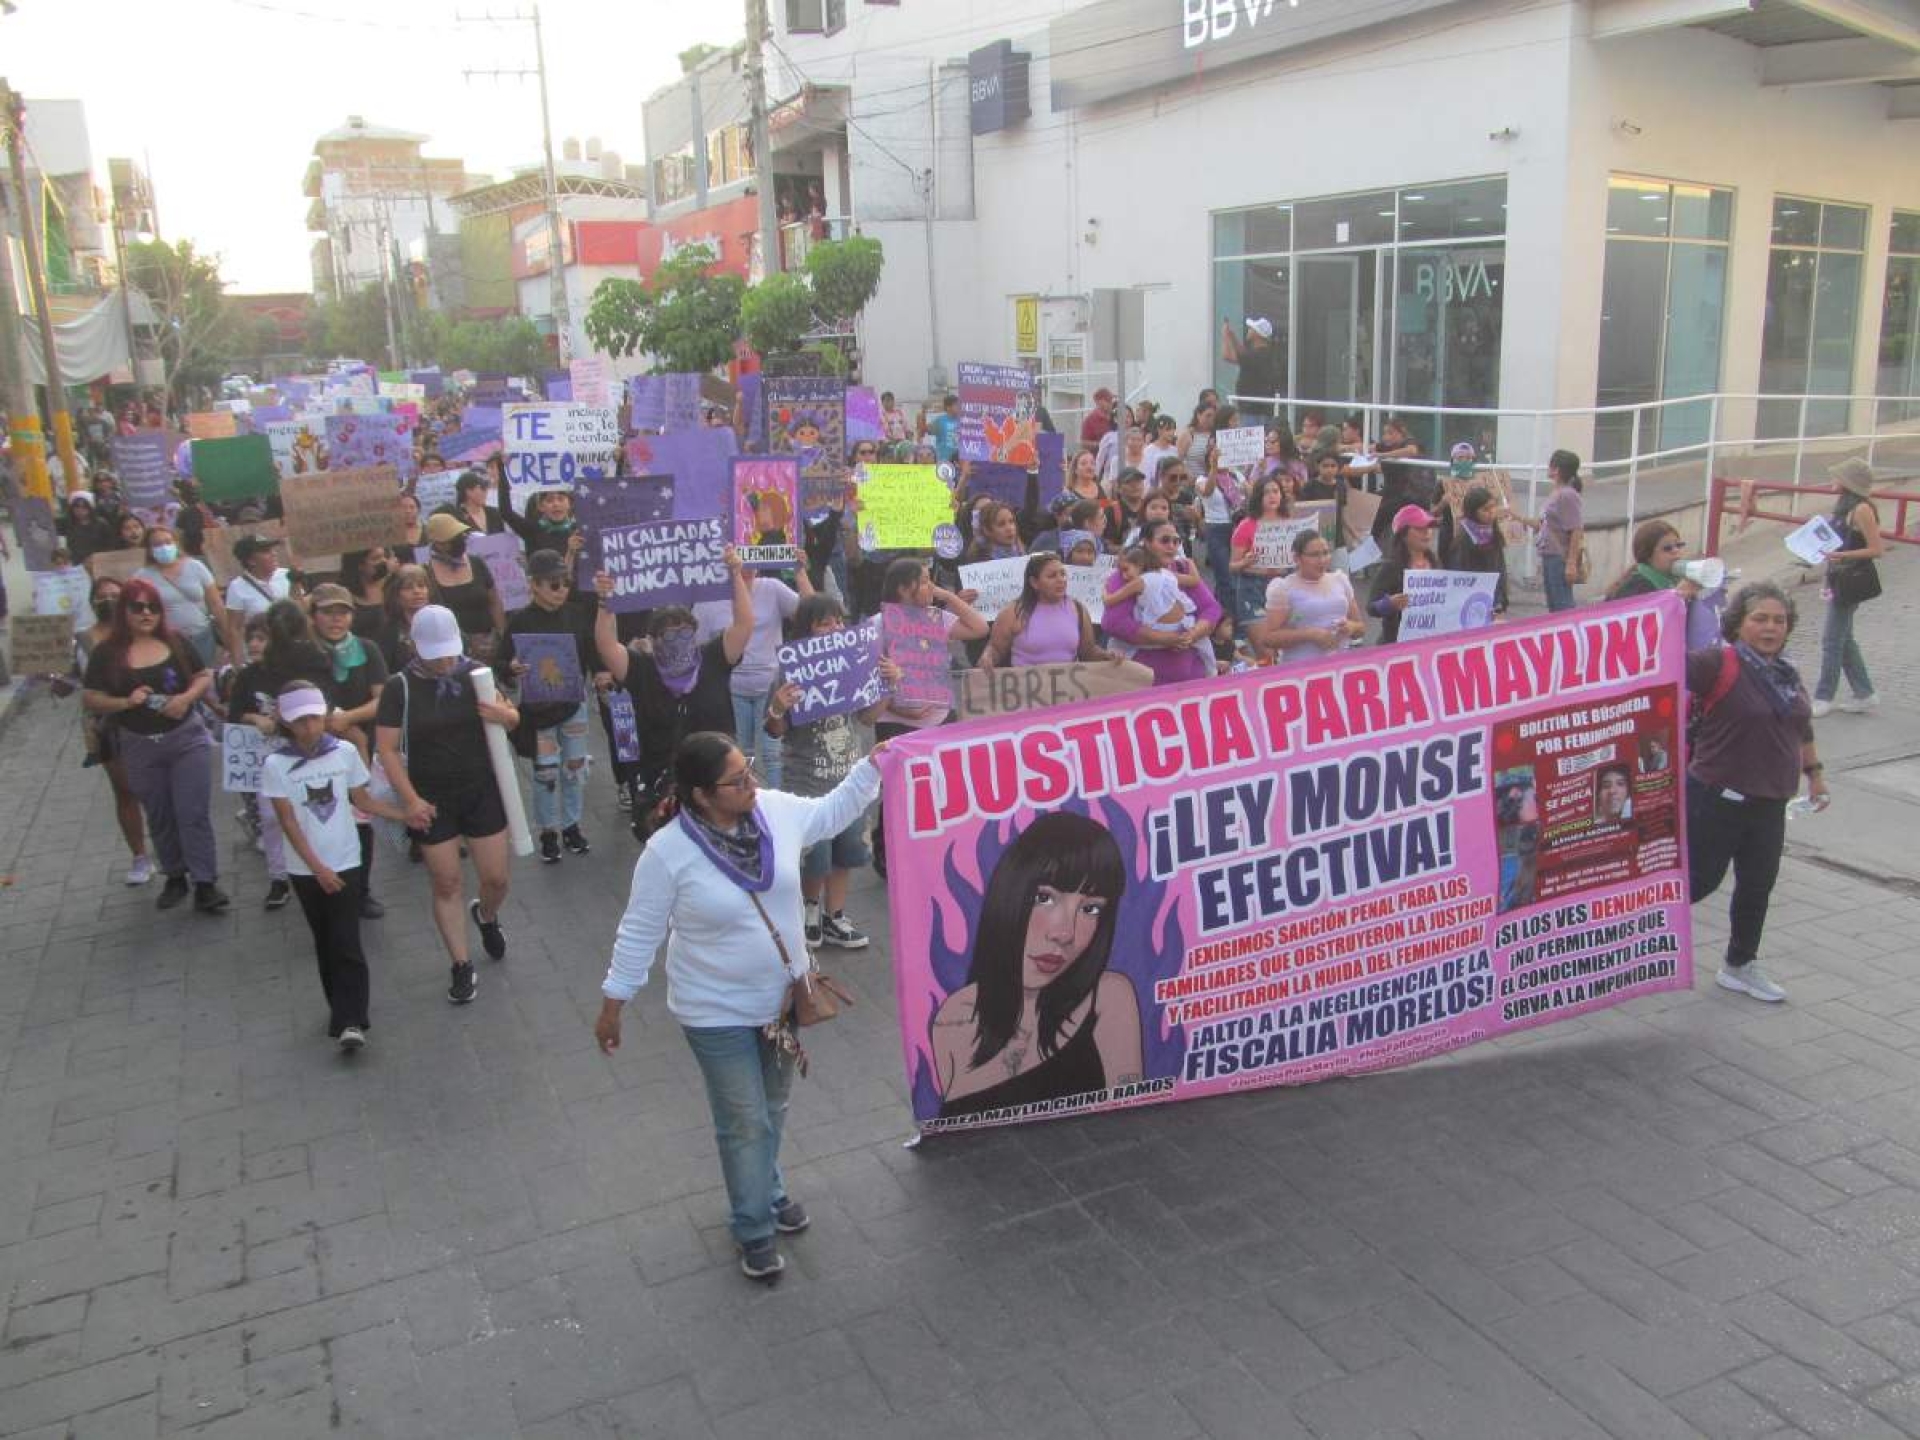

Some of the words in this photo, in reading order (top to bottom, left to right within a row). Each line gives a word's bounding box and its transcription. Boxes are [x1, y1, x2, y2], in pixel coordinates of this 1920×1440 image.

[972, 76, 999, 102] BBVA
[1417, 260, 1492, 302] BBVA
[510, 412, 555, 441] TE
[506, 451, 576, 486] CREO
[602, 534, 625, 553] NI
[627, 519, 722, 546] CALLADAS
[604, 554, 627, 574] NI
[631, 539, 725, 571] SUMISAS
[777, 630, 857, 665] QUIERO
[785, 655, 850, 683] MUCHA
[965, 664, 1091, 715] LIBRES
[1263, 661, 1429, 754] PARA
[1437, 613, 1659, 716] MAYLIN!
[1573, 710, 1590, 727] DE
[1535, 738, 1562, 755] POR
[1153, 779, 1274, 876] ¡LEY
[1290, 731, 1484, 836] MONSE
[1197, 811, 1453, 932] EFECTIVA!
[1278, 909, 1348, 945] SANCIÓN
[1350, 896, 1395, 926] PENAL
[1398, 885, 1438, 914] PARA
[1440, 877, 1468, 901] LOS
[1522, 914, 1551, 939] LOS
[1555, 903, 1588, 929] VES
[1591, 880, 1682, 920] DENUNCIA!
[1537, 919, 1635, 959] PERMITAMOS
[1637, 910, 1665, 933] QUE
[1157, 961, 1257, 1001] FAMILIARES
[1260, 949, 1291, 977] QUE
[1294, 922, 1405, 966] OBSTRUYERON
[1408, 915, 1426, 936] LA
[1429, 897, 1494, 933] JUSTICIA
[1168, 1005, 1179, 1024] Y
[1183, 979, 1289, 1022] FACILITARON
[1293, 974, 1312, 995] LA
[1314, 958, 1364, 990] HUIDA
[1367, 953, 1394, 974] DEL
[1396, 924, 1484, 967] FEMINICIDA!
[1500, 977, 1515, 997] EL
[1518, 946, 1631, 990] CONOCIMIENTO
[1634, 934, 1678, 958] LEGAL
[1258, 1012, 1273, 1035] A
[1279, 1004, 1303, 1029] LA
[1308, 967, 1438, 1022] NEGLIGENCIA
[1442, 956, 1467, 984] DE
[1469, 949, 1490, 976] LA
[1503, 993, 1550, 1020] SIRVA
[1553, 989, 1564, 1007] A
[1567, 985, 1585, 1003] LA
[1588, 959, 1677, 999] IMPUNIDAD!
[1186, 1020, 1339, 1082] FISCALIA
[1346, 975, 1494, 1046] MORELOS!
[1051, 1089, 1109, 1112] CHINO
[1112, 1077, 1175, 1099] RAMOS
